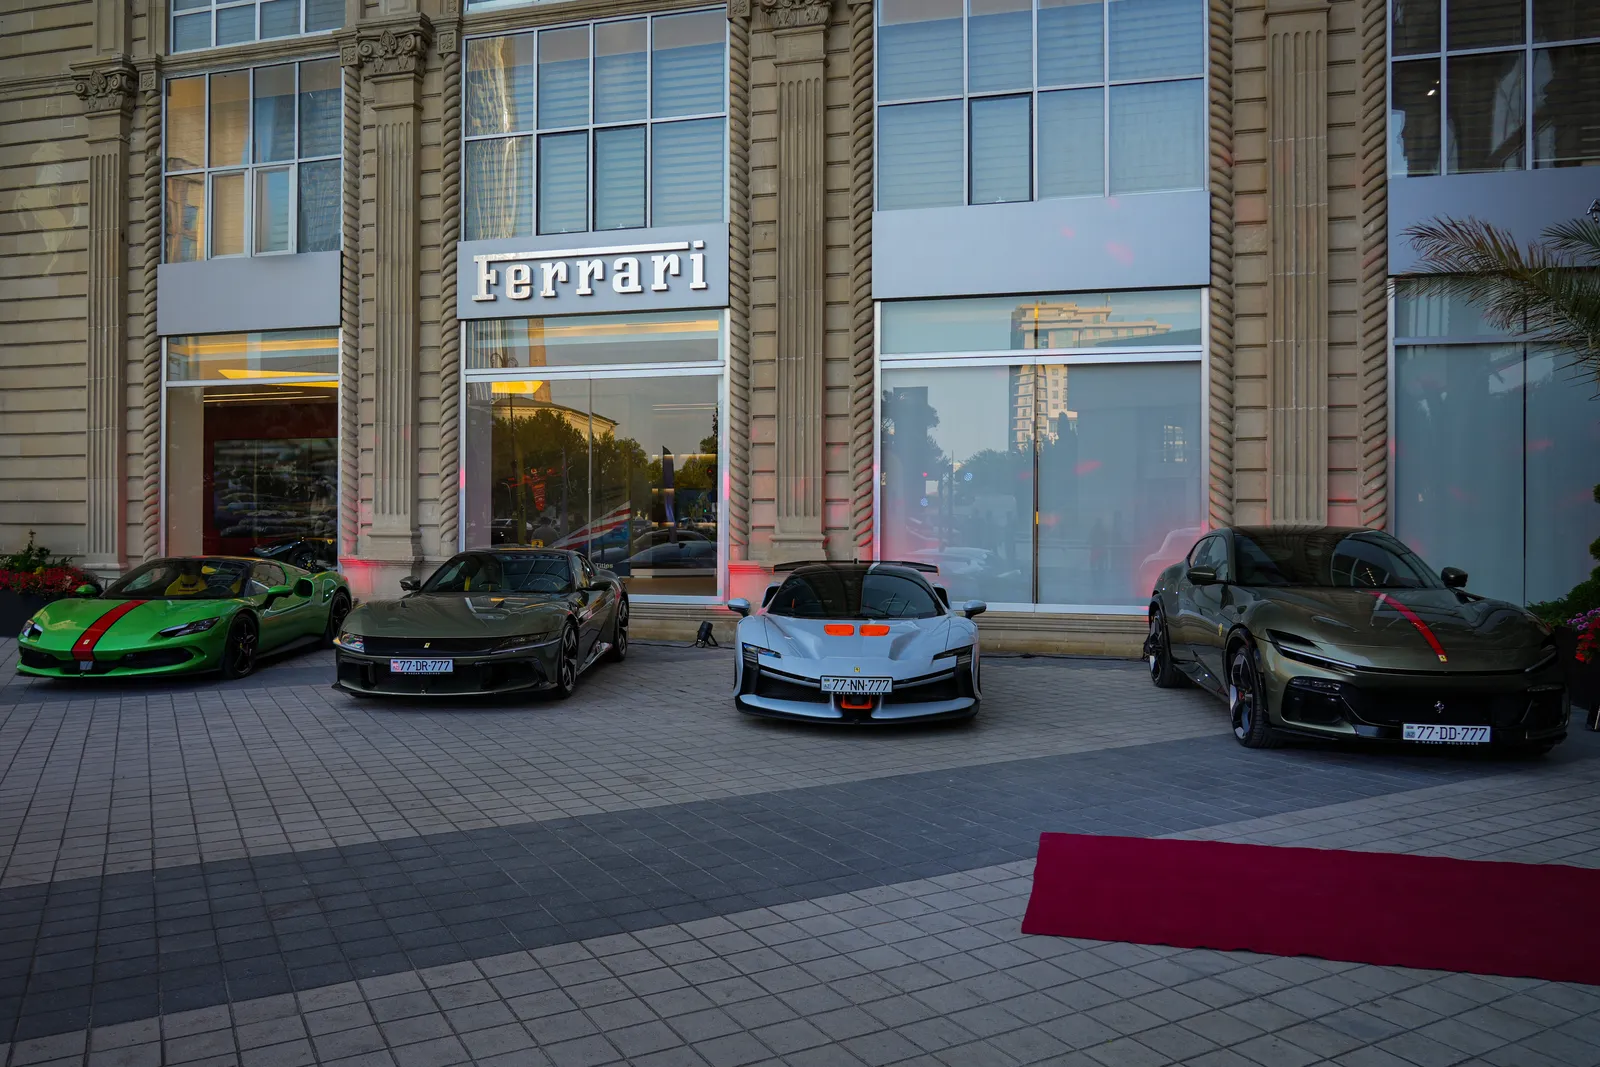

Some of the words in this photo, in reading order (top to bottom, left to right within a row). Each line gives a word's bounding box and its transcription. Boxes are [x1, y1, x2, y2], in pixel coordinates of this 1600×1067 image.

[472, 240, 707, 302] Ferrari
[400, 660, 450, 671] 77-DR-777
[832, 678, 890, 691] 77-NN-777
[1417, 726, 1487, 741] 77-DD-777
